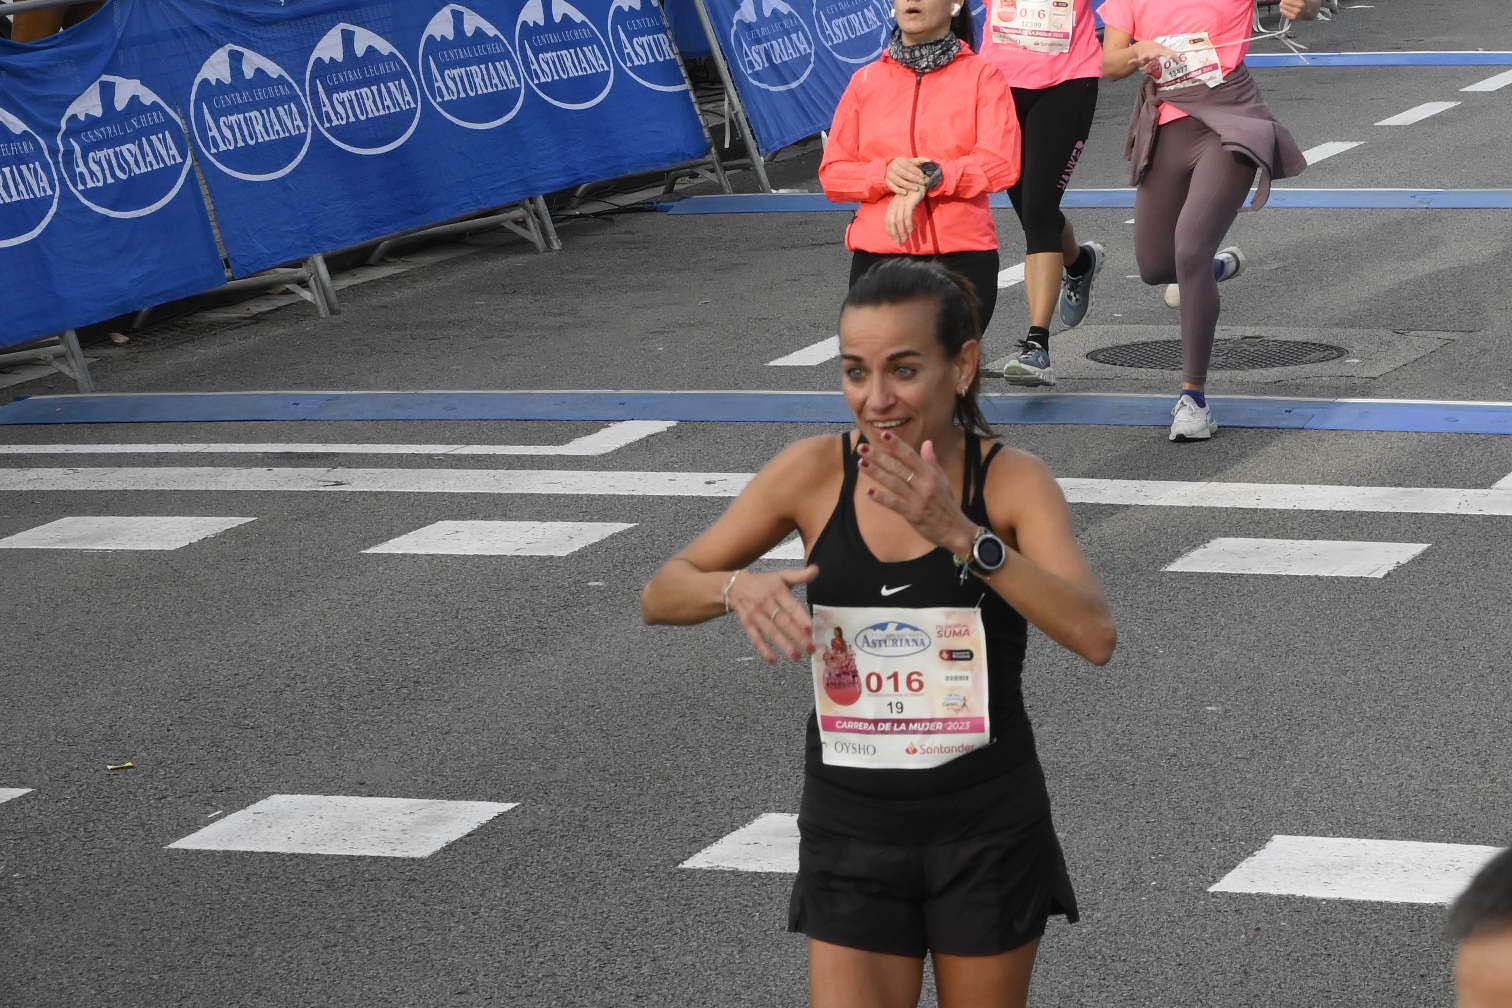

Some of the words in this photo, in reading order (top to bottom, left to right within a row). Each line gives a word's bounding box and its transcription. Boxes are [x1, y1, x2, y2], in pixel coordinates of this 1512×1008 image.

[439, 45, 472, 61] CENTRAL
[473, 40, 505, 57] LECHERA
[617, 24, 675, 68] ASTUR
[327, 68, 362, 86] CENTRAL
[364, 60, 400, 79] LECHERA
[523, 39, 609, 85] ASTURIANA
[428, 54, 520, 103] ASTURIANA
[213, 91, 251, 108] CENTRAL
[315, 77, 416, 129] ASTURIANA
[202, 101, 306, 154] ASTURIANA
[71, 130, 183, 191] ASTURIANA
[862, 636, 926, 648] ASTURIANA
[936, 630, 970, 639] SUMA
[865, 671, 925, 694] 016
[887, 701, 904, 714] 19
[835, 721, 876, 732] CARRERA
[877, 723, 893, 731] DE
[894, 723, 907, 731] LA
[908, 723, 943, 731] MUJER
[834, 741, 877, 756] OYSHO
[919, 744, 976, 755] Santander
